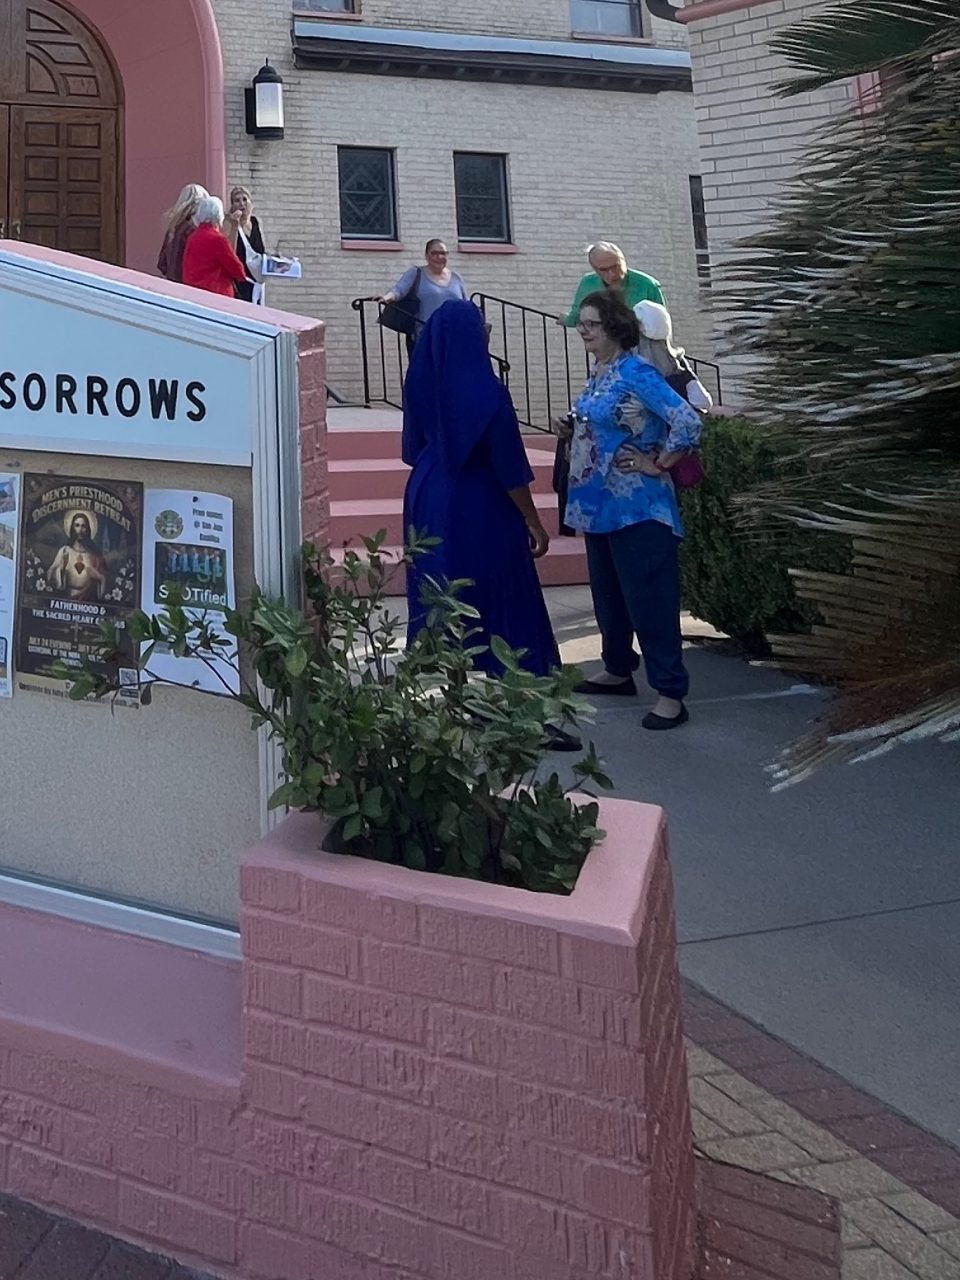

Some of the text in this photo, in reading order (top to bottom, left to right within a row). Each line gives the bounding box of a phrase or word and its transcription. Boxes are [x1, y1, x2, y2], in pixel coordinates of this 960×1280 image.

[0, 371, 207, 422] SORROWS
[42, 485, 124, 511] MEN'S PRIESTHOOD
[32, 498, 131, 532] DISCERNMENT RETREAT
[159, 585, 227, 606] SOTified
[32, 609, 44, 618] THE
[46, 611, 71, 621] SACRED
[72, 615, 93, 624] HEART
[50, 600, 98, 615] FATHERHOOD
